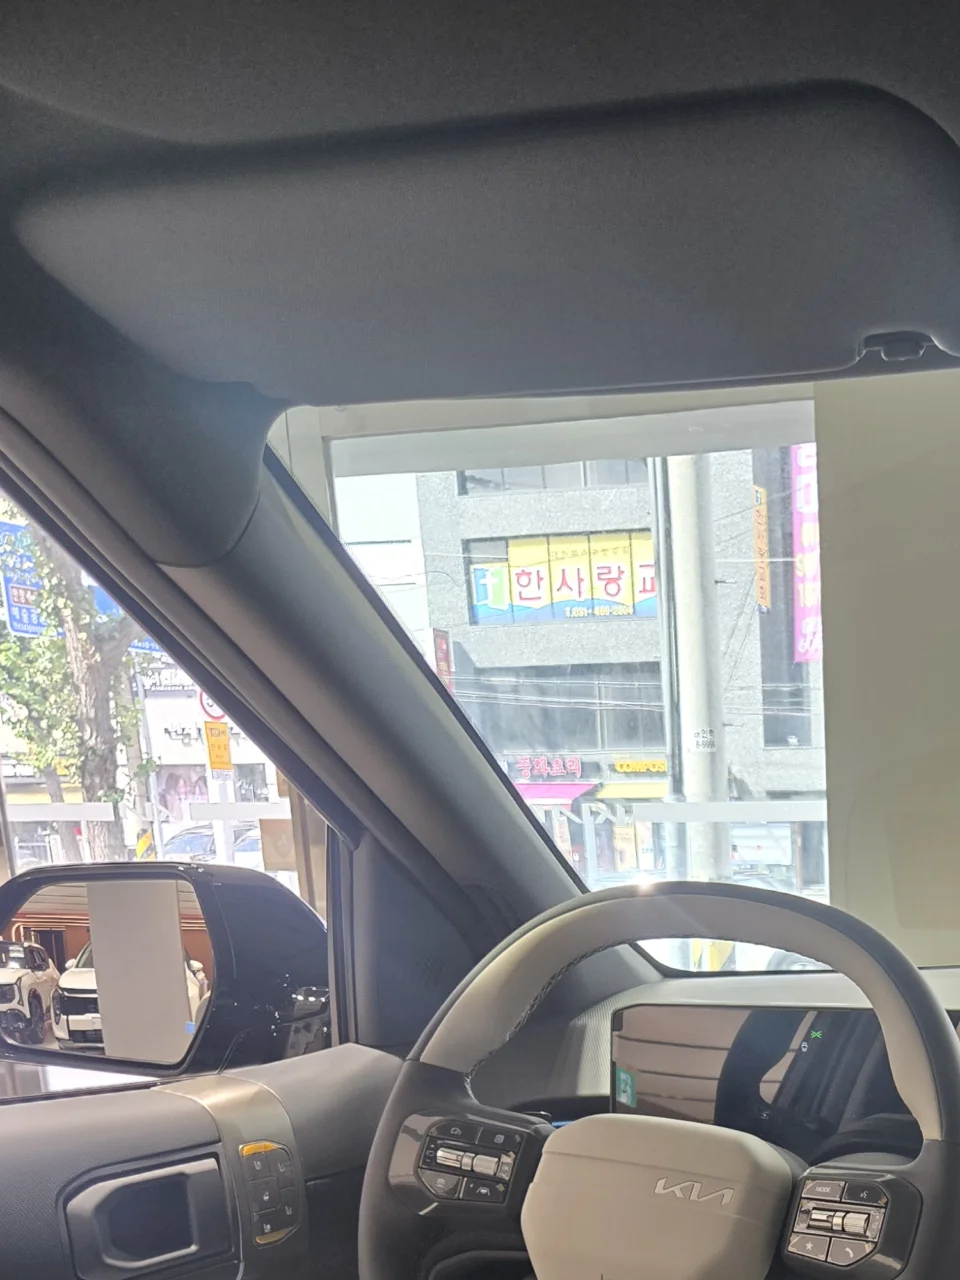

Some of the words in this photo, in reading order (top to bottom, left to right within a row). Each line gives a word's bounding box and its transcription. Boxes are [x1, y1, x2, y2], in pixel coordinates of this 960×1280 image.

[516, 755, 583, 780] 중화요리
[614, 760, 667, 773] COMPOS
[654, 1176, 735, 1206] KIA
